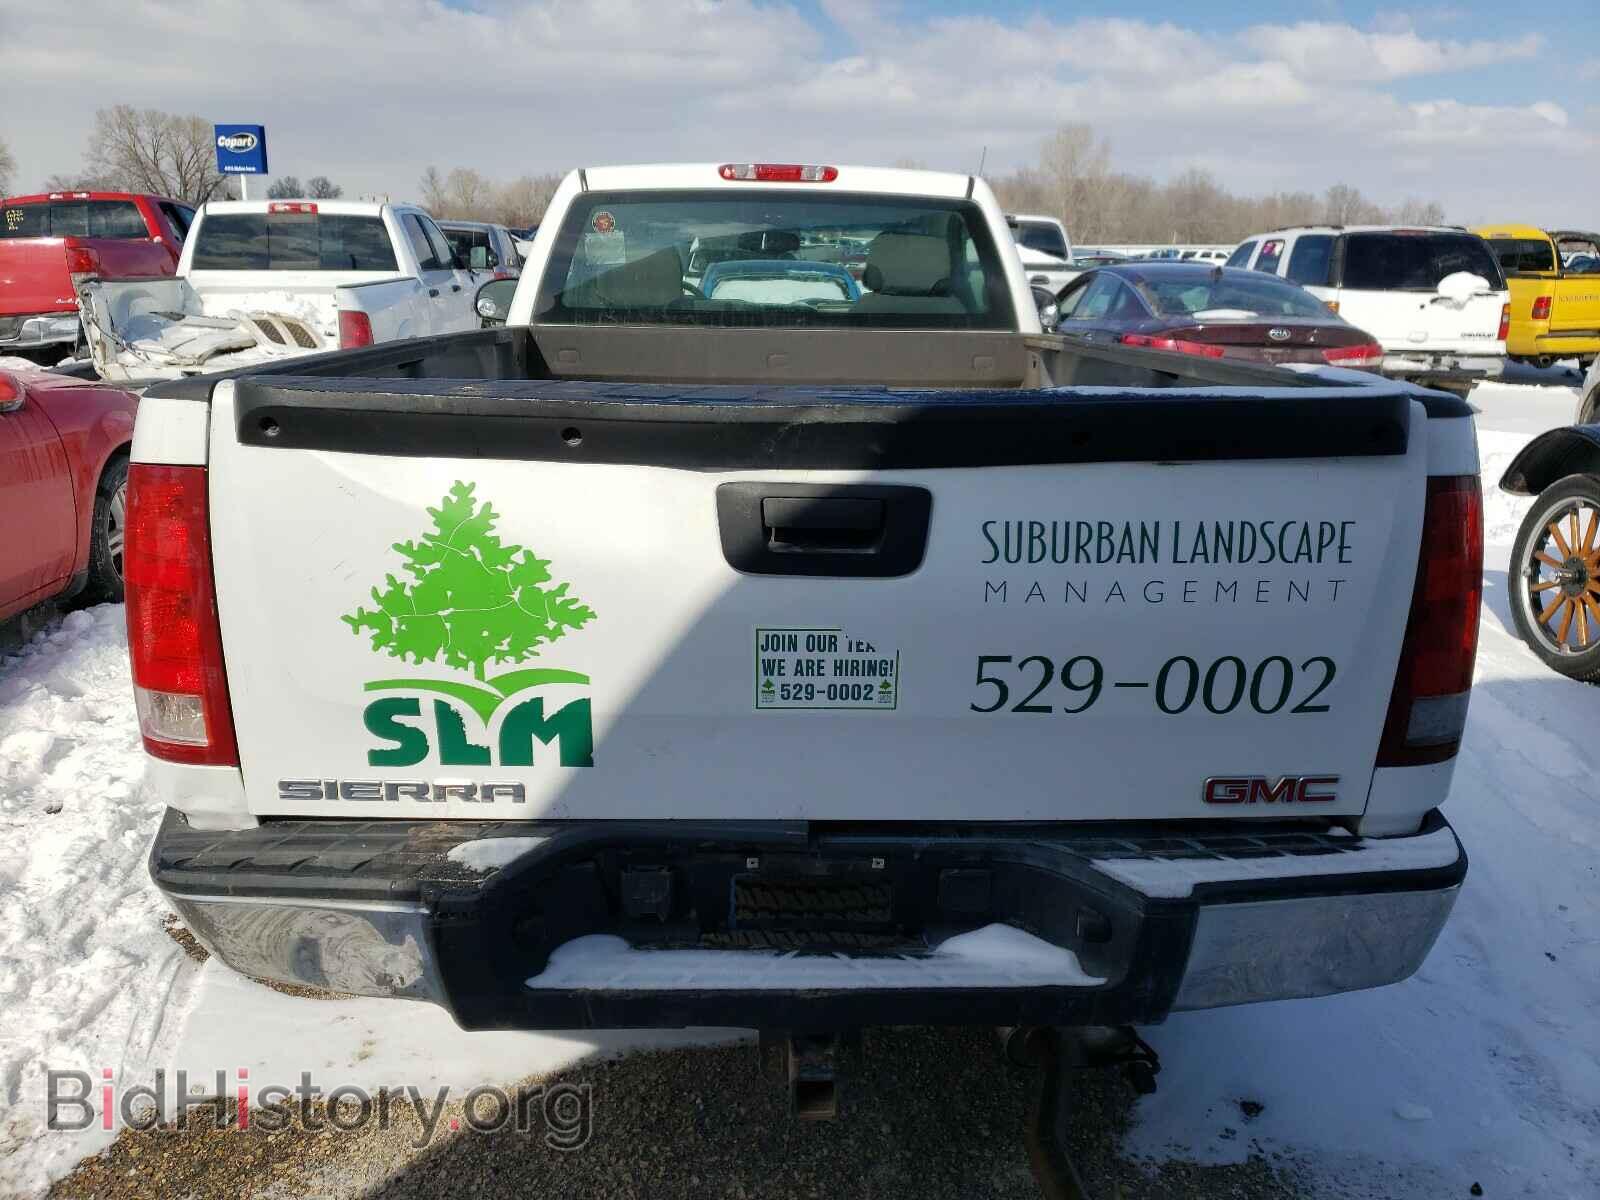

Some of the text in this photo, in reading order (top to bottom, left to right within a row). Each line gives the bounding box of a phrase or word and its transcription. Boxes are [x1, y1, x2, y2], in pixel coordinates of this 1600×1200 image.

[217, 135, 252, 148] Copart
[981, 520, 1356, 564] SUBURBAN LANDSCAPE
[983, 580, 1347, 603] MANAGEMENT
[760, 634, 798, 652] JOIN
[806, 634, 838, 652] OUR
[761, 659, 894, 677] WE ARE HIRING!
[780, 683, 874, 701] 529-0002
[969, 655, 1337, 714] 529-0002
[364, 696, 594, 767] SLM
[277, 778, 526, 804] SIERRA
[1203, 775, 1341, 804] GMC
